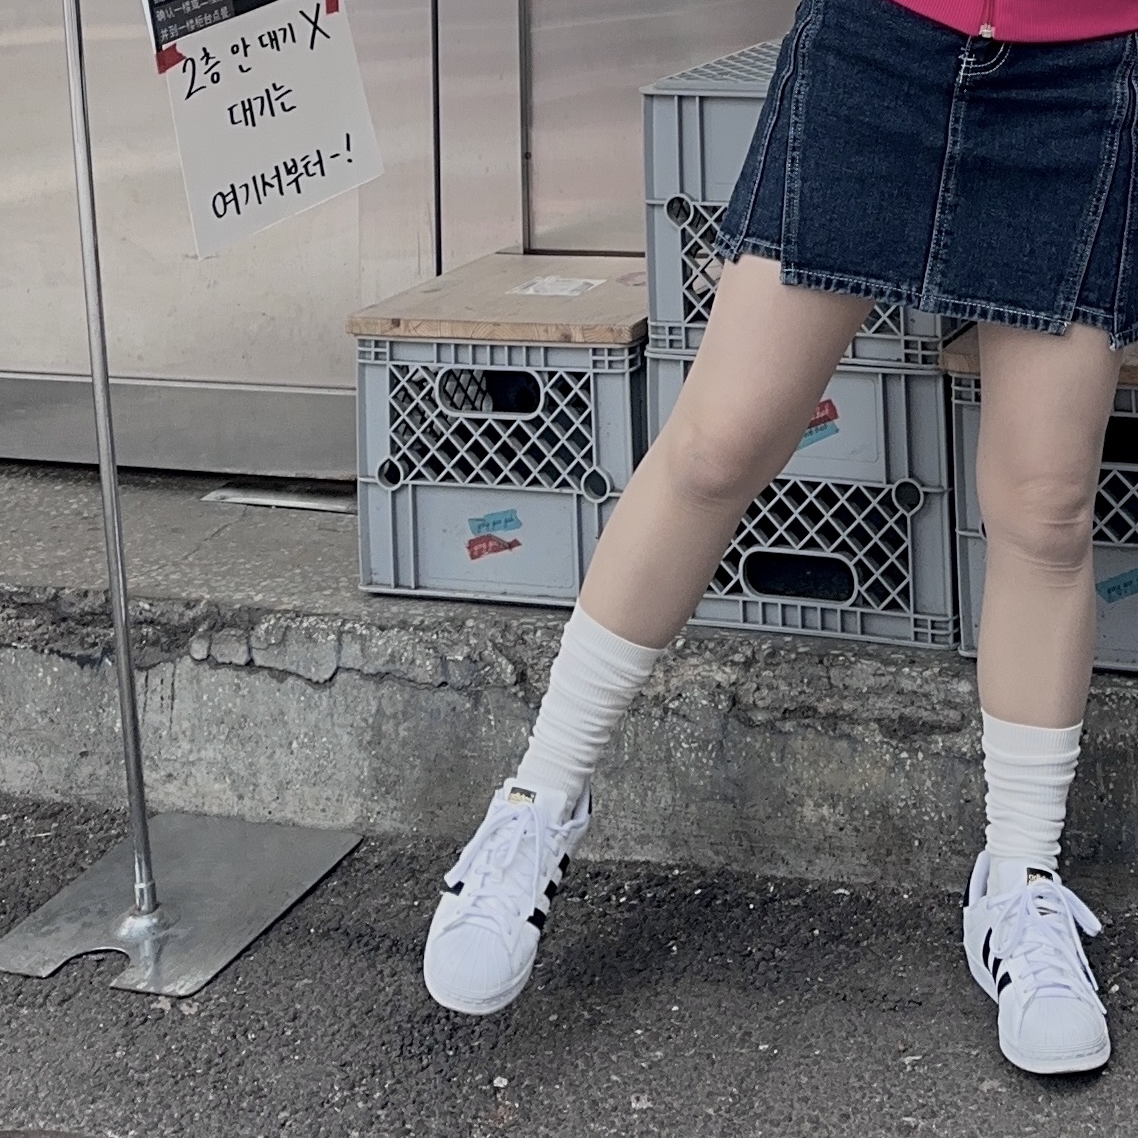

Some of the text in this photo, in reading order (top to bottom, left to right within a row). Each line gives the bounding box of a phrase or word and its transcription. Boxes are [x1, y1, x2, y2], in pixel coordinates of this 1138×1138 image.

[182, 46, 221, 101] 2층
[230, 37, 252, 74] 안
[257, 22, 297, 52] 대기
[227, 82, 297, 128] 대기는
